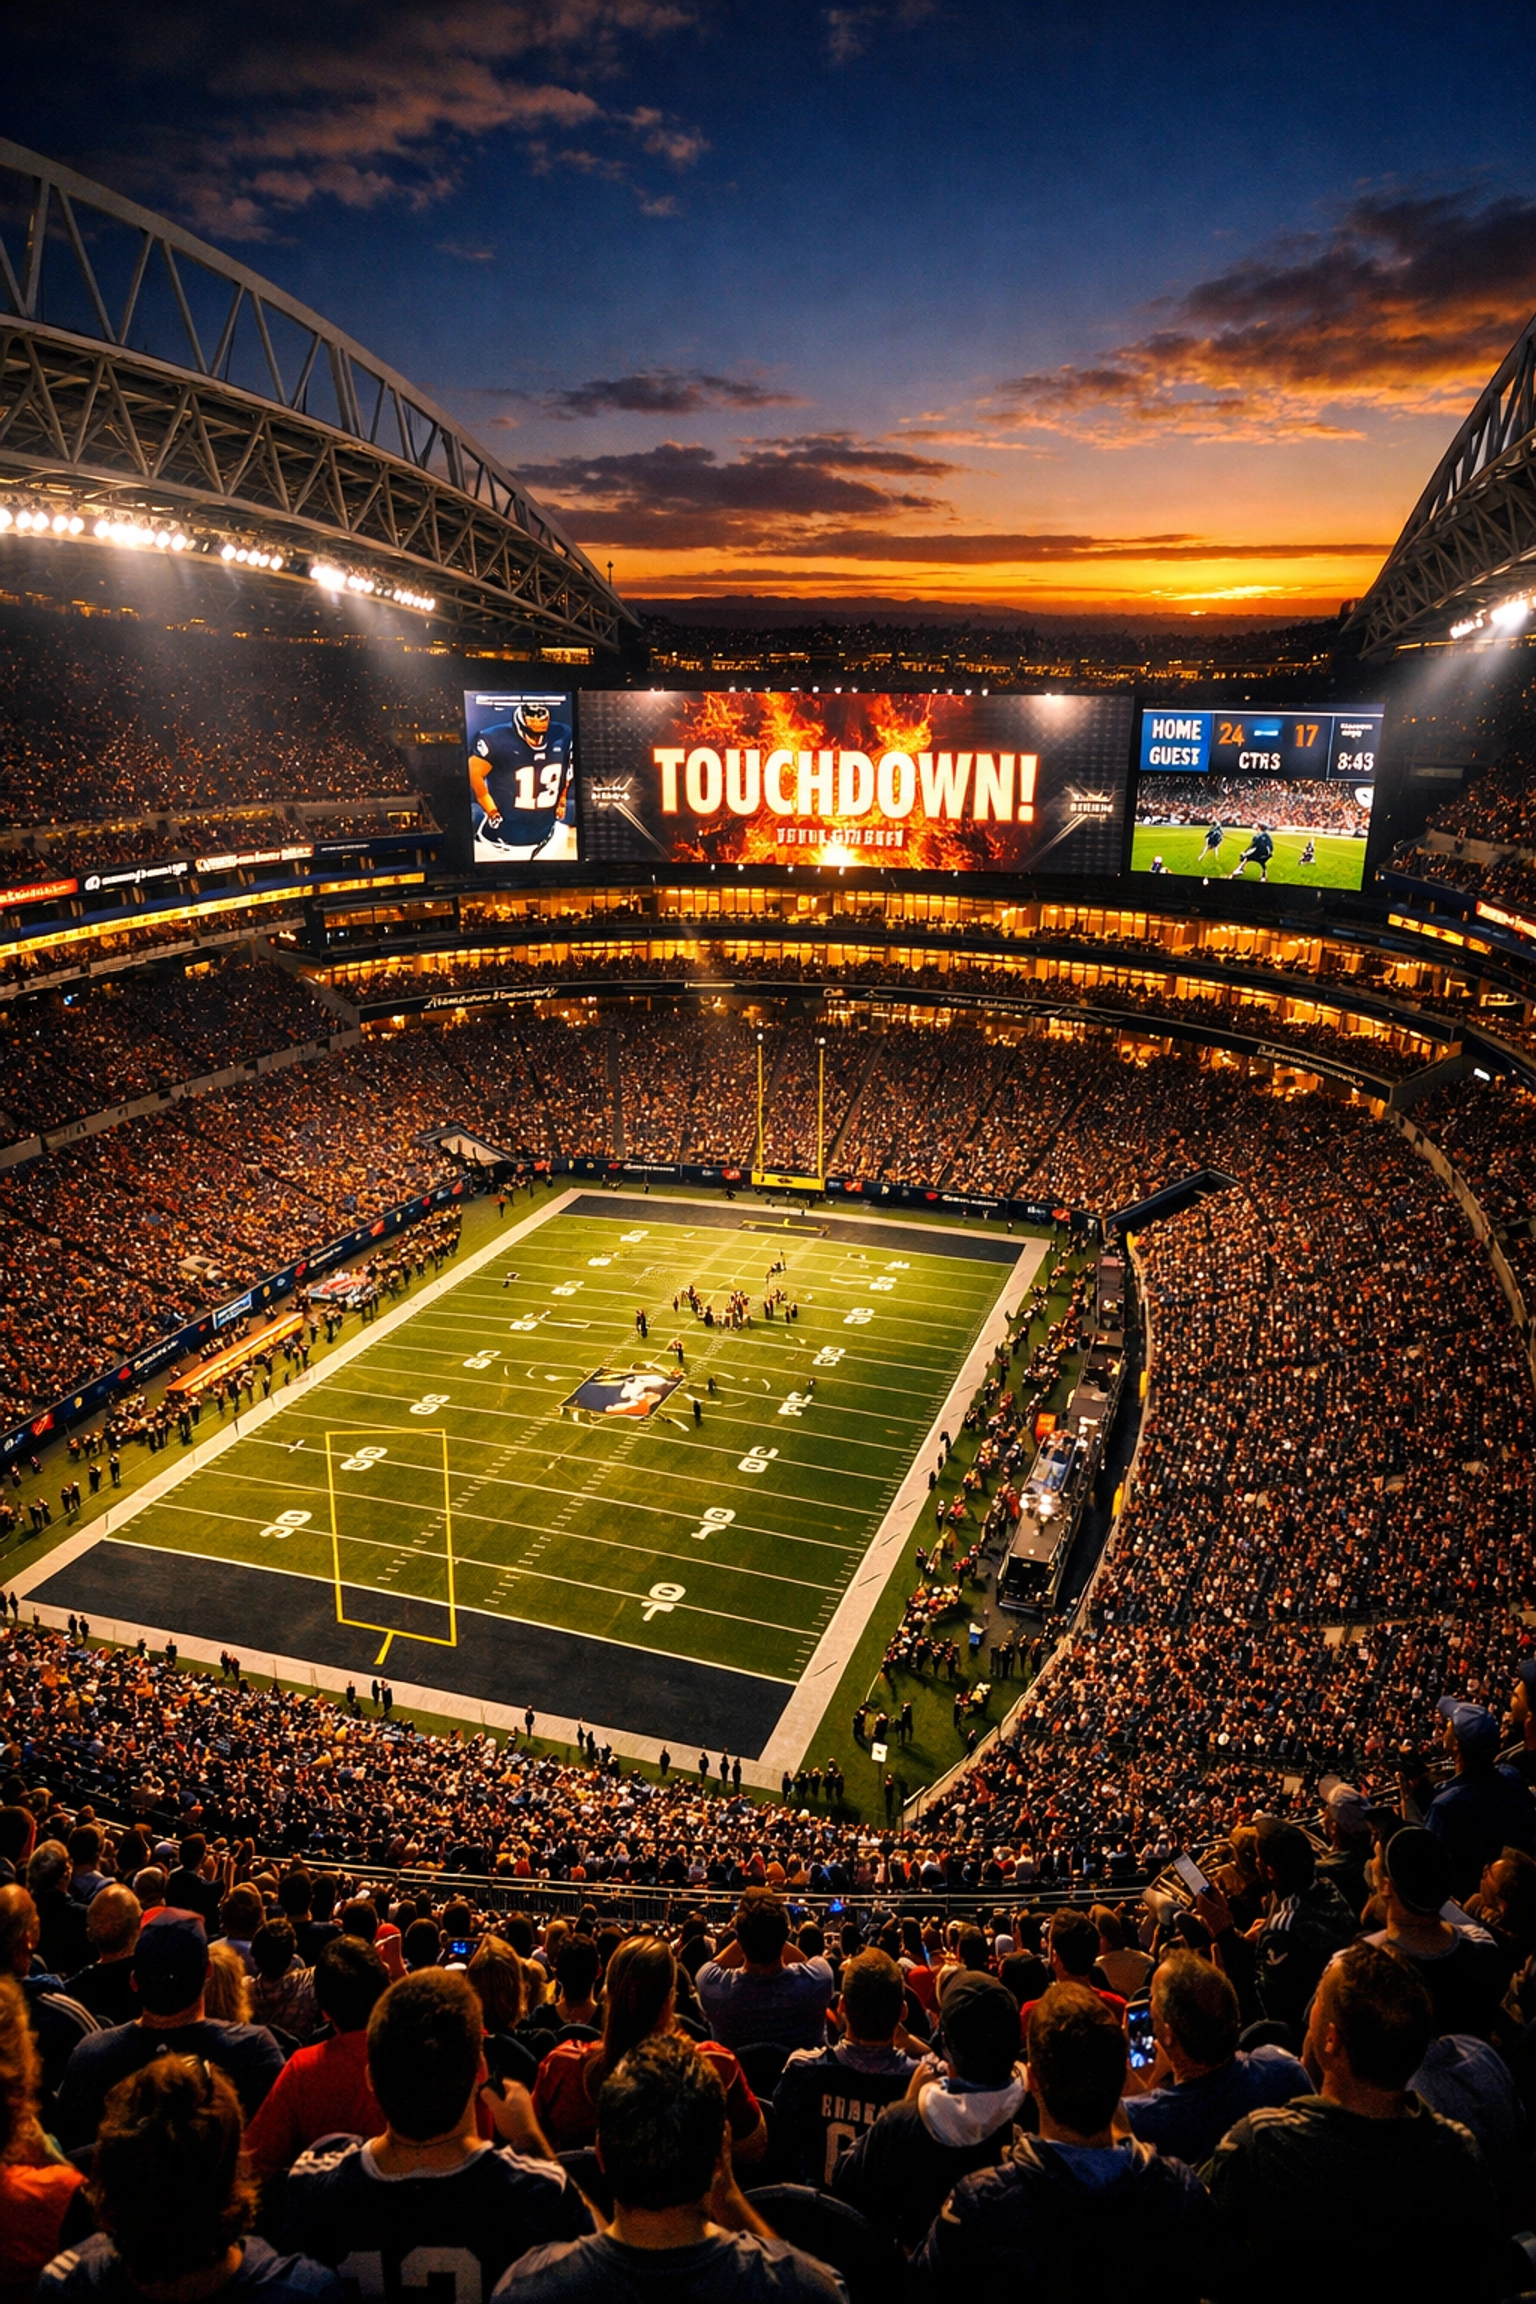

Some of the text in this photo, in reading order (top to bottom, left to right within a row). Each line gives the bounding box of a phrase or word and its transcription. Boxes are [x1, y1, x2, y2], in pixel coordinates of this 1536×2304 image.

[1152, 719, 1202, 740] HOME
[1218, 722, 1245, 747] 24
[1295, 724, 1319, 747] 17
[1149, 746, 1201, 766] GUEST
[653, 747, 1038, 822] TOUCHDOWN!
